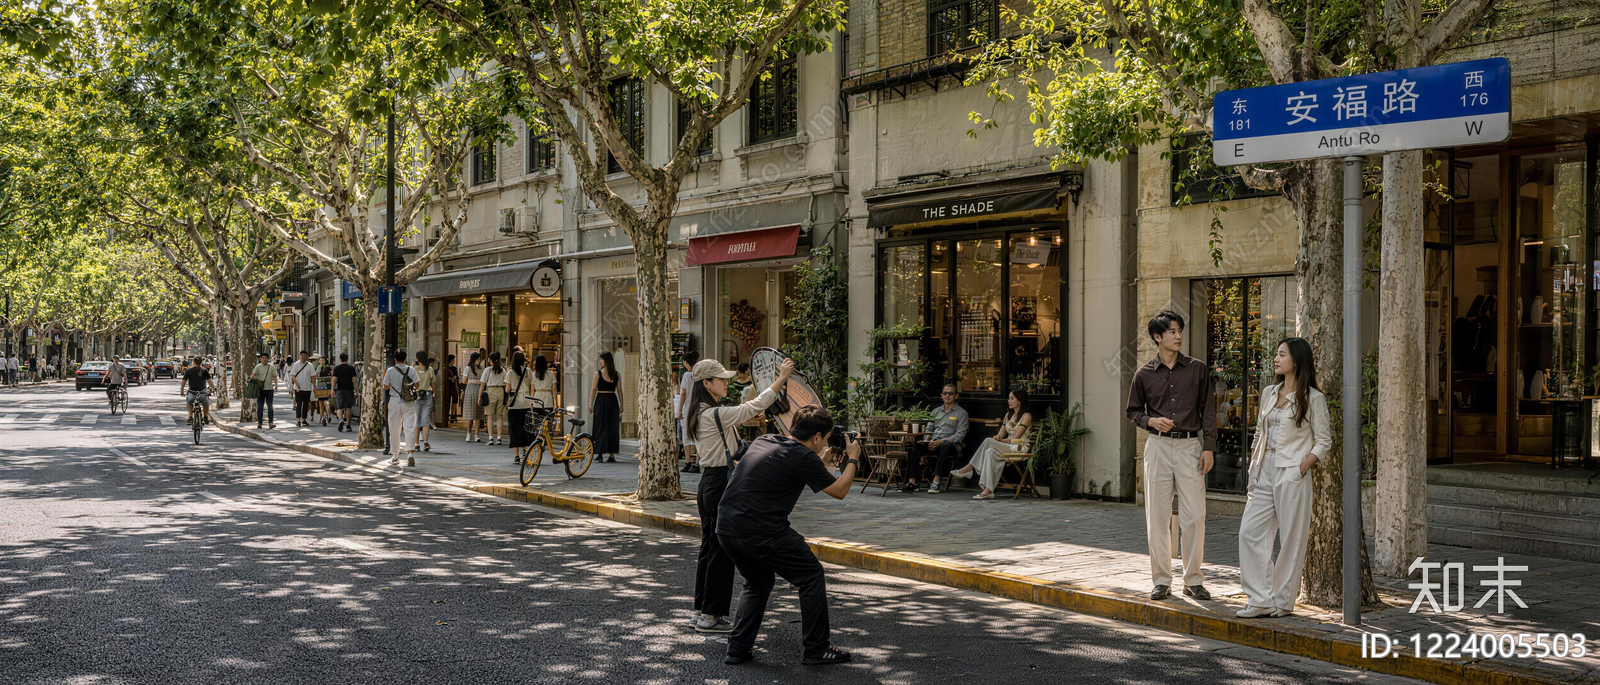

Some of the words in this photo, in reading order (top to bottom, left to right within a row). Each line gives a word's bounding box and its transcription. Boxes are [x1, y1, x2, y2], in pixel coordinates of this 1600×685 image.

[1464, 70, 1485, 89] 西
[1231, 98, 1248, 115] 东
[1285, 78, 1420, 126] 安福路
[1460, 92, 1488, 107] 176
[1228, 118, 1250, 131] 181
[1464, 120, 1484, 136] W
[1317, 133, 1353, 149] Antu
[1358, 131, 1380, 145] Ro
[1234, 142, 1245, 158] E
[922, 207, 946, 219] THE
[951, 200, 994, 216] SHADE
